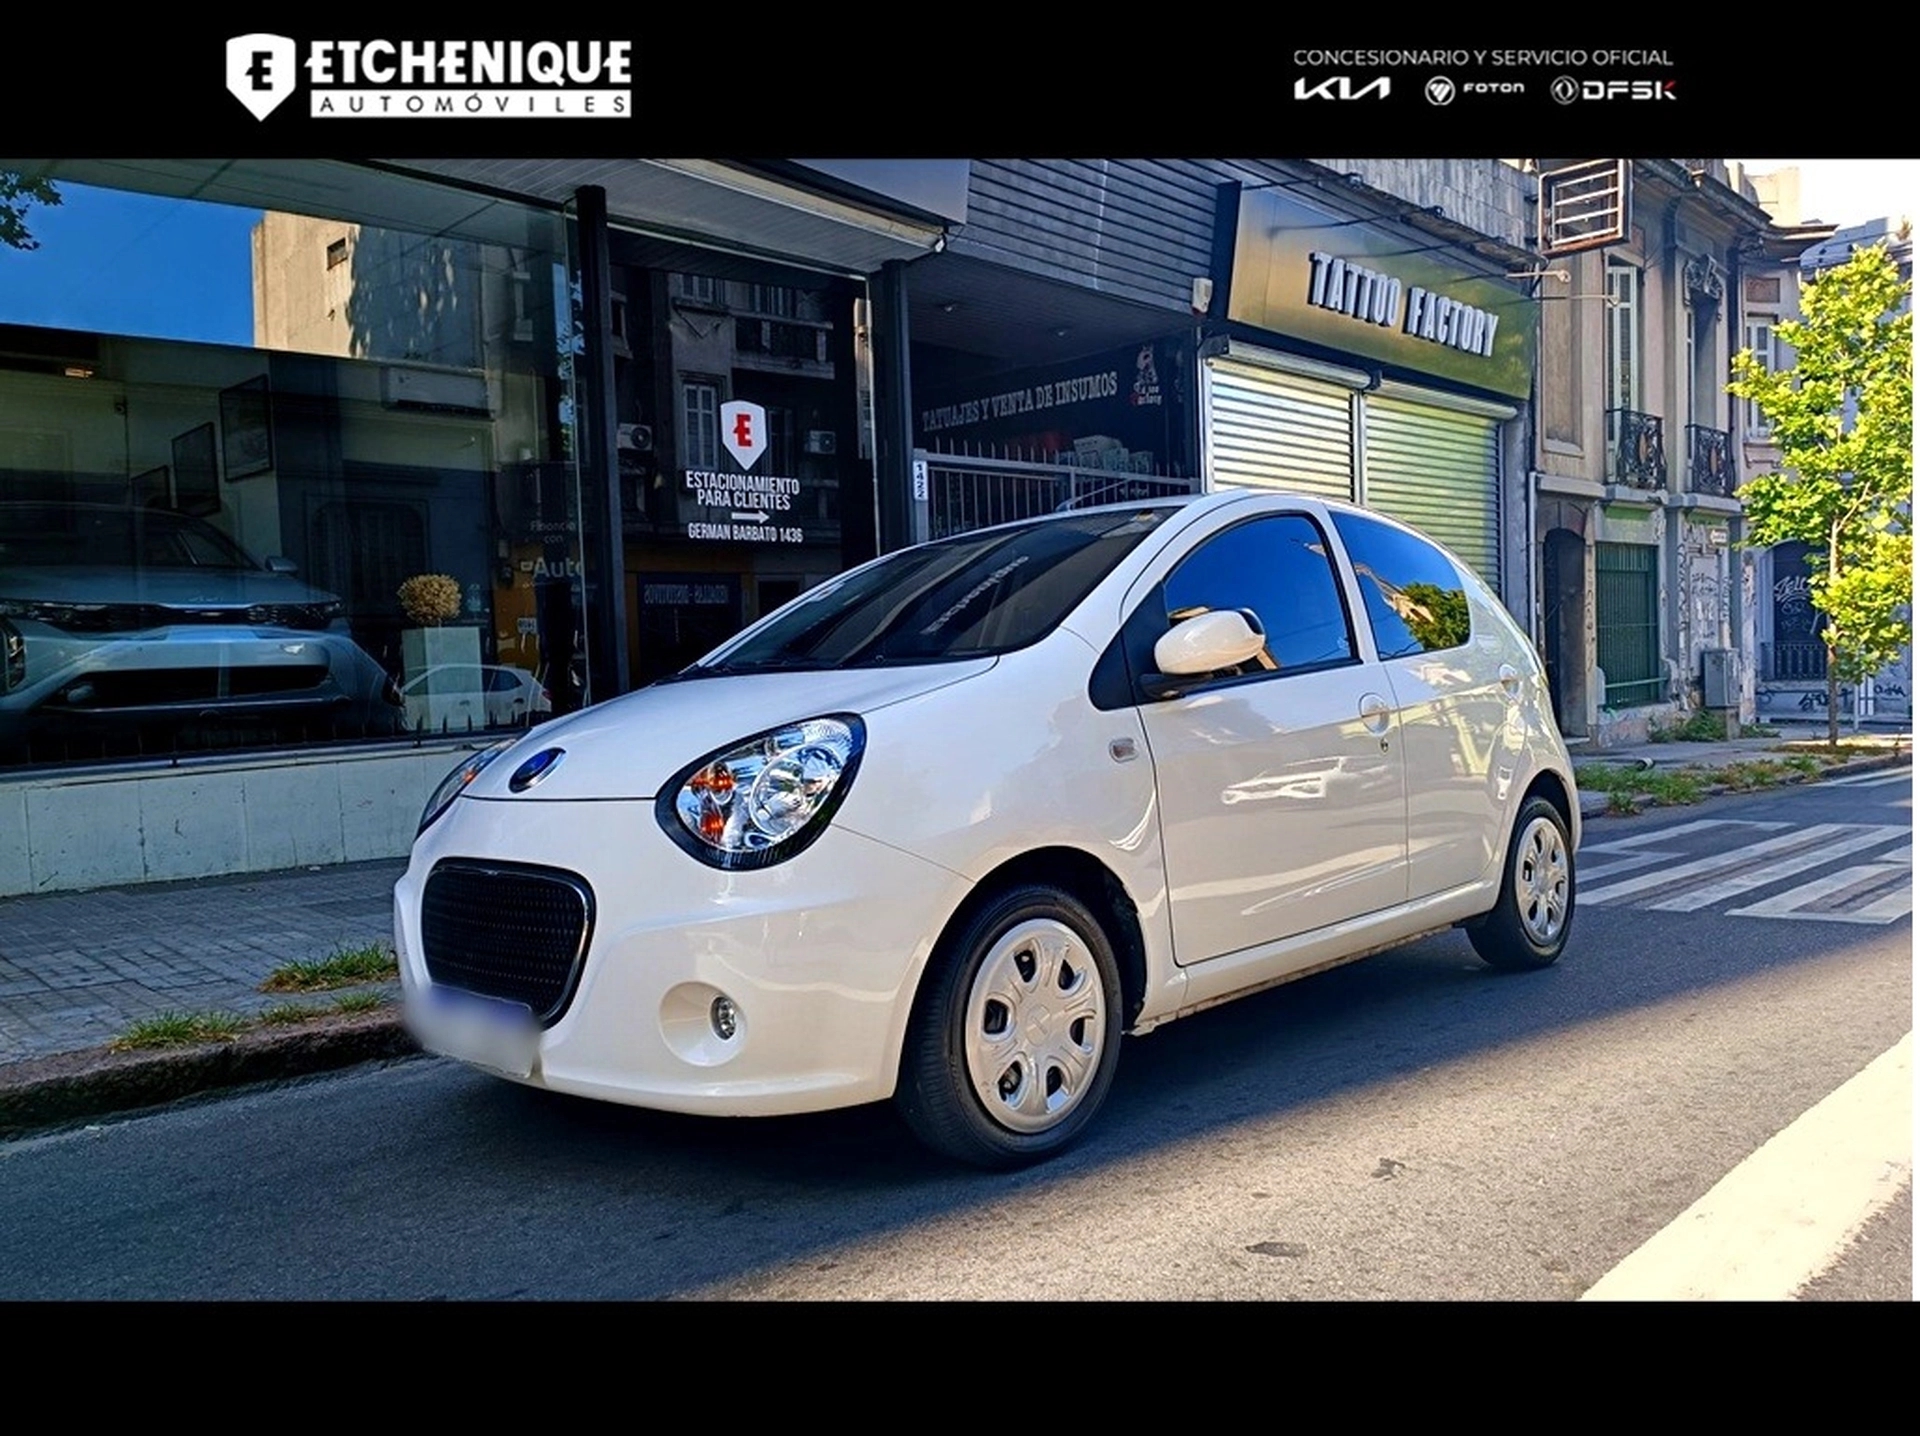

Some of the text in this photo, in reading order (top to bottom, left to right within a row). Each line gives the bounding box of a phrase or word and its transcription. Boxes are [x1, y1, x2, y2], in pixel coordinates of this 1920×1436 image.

[1308, 252, 1499, 358] TATTOO FACTORY
[922, 401, 980, 432] TATUAJES
[981, 397, 992, 421] Y
[991, 389, 1035, 419] VENTA
[1035, 385, 1054, 411] DE
[1055, 371, 1119, 405] INSUMOS
[685, 470, 801, 496] ESTACIONAMIENTO
[697, 489, 791, 511] PARA CLIENTES
[688, 522, 804, 543] GERMAN BARBATO 1436
